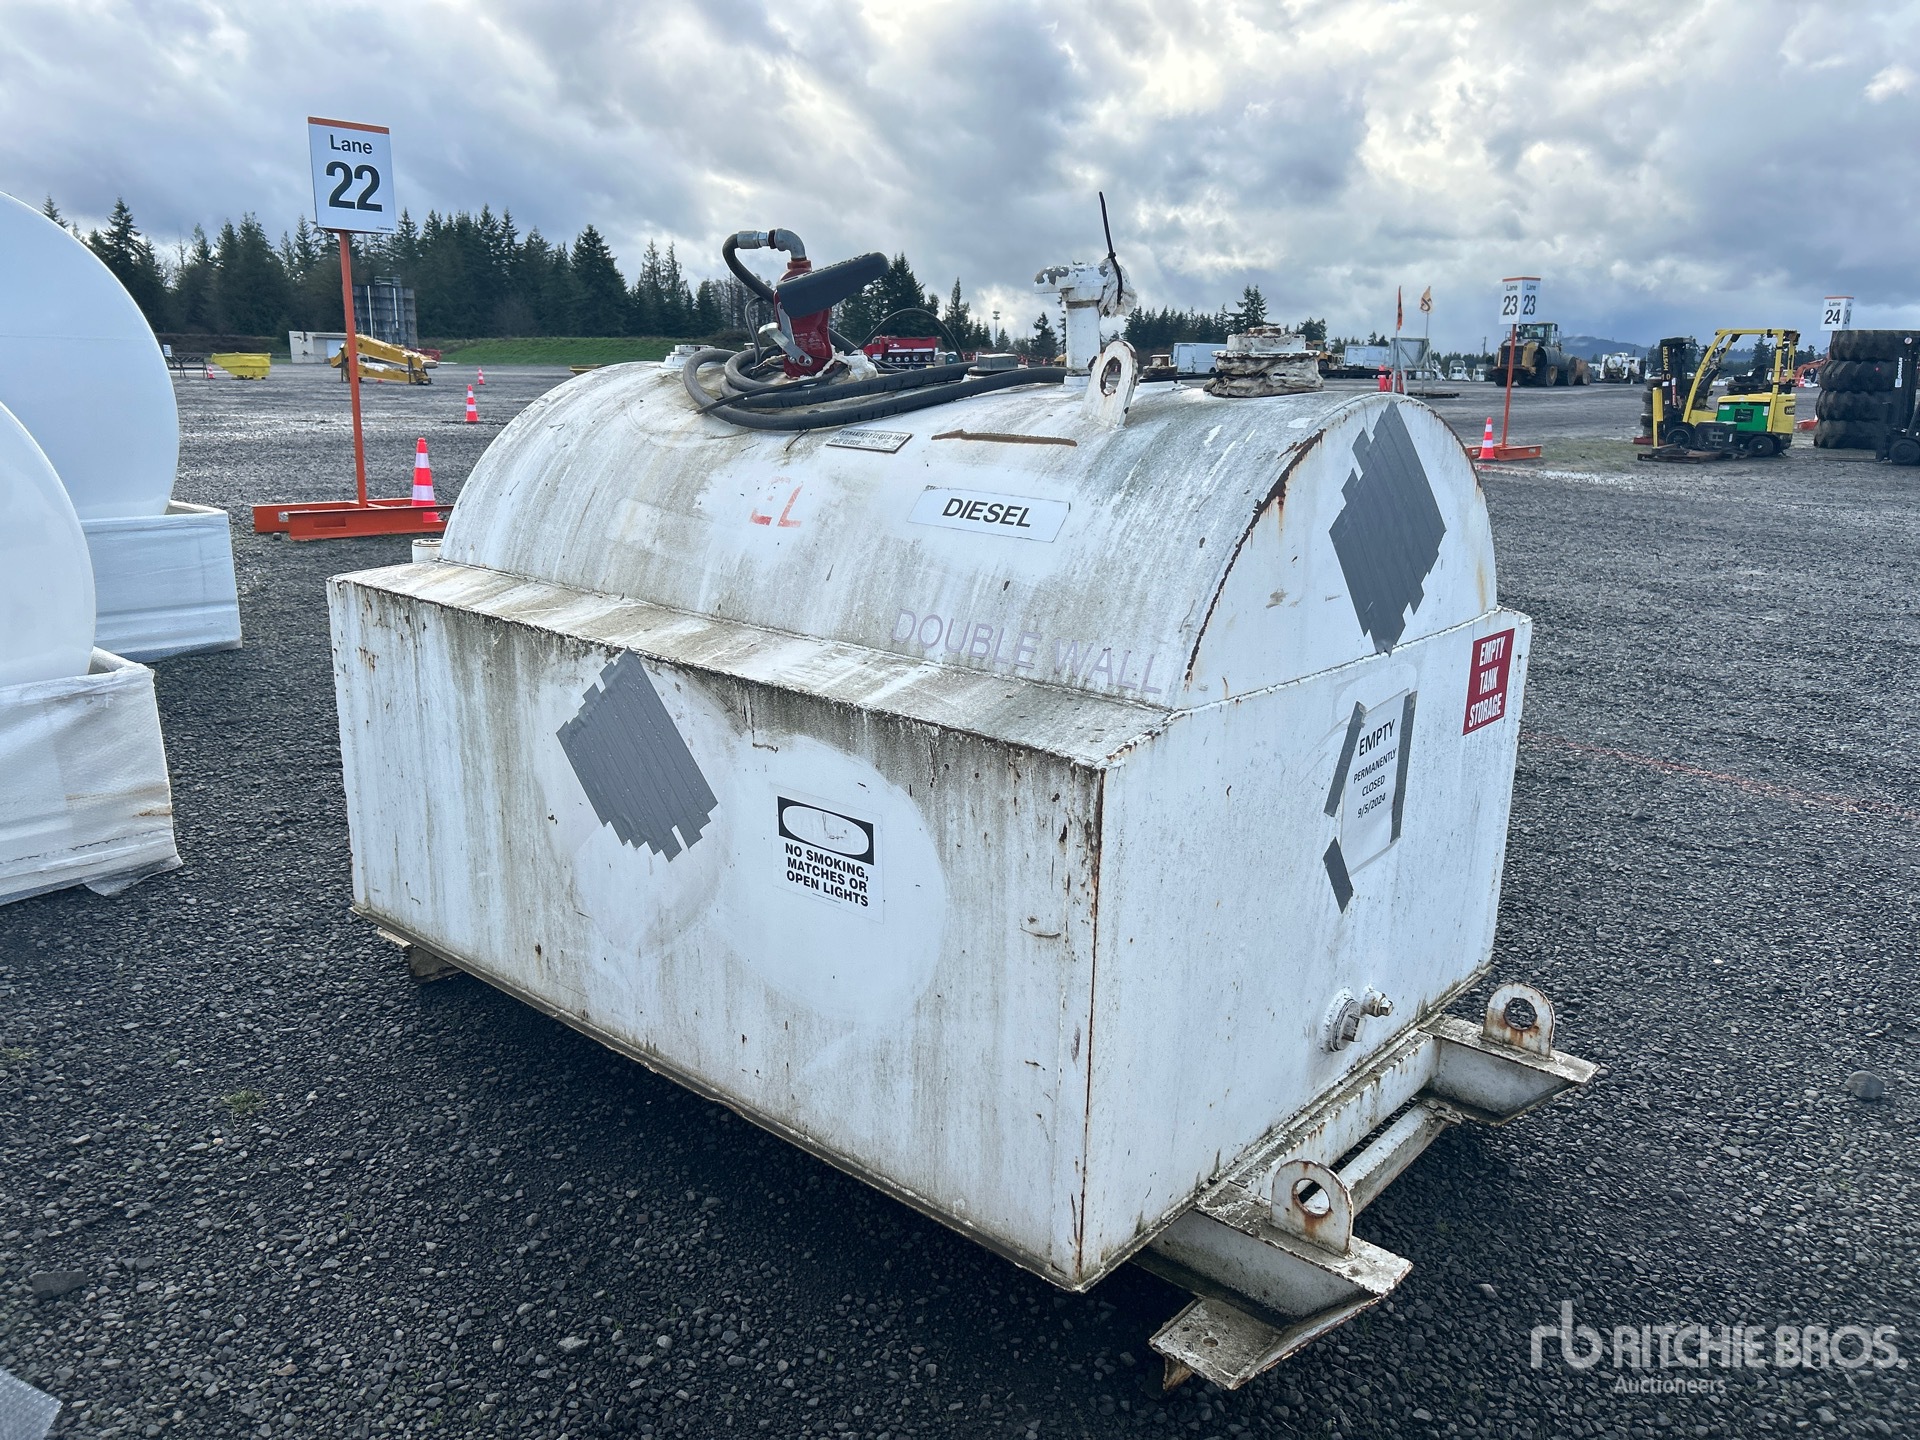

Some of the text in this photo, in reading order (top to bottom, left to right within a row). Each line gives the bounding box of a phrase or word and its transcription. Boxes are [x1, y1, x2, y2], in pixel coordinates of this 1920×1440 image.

[329, 134, 373, 155] Lane
[325, 161, 383, 212] 22
[1502, 294, 1518, 316] 23
[1522, 294, 1536, 316] 23
[1824, 309, 1841, 325] 24
[942, 497, 1032, 528] DIESEL
[891, 609, 1162, 694] DOUBLE WALL
[1479, 636, 1506, 667] EMPTY
[1479, 666, 1499, 695] TANK
[1468, 693, 1503, 728] STORAGE
[1358, 719, 1396, 757] EMPTY
[1353, 748, 1397, 784] PERMANENTLY
[1362, 775, 1386, 797] CLOSED
[1357, 792, 1387, 819] 9/5/2024
[785, 842, 869, 882] NO SMOKING,
[787, 857, 868, 893] MATCHES OR
[786, 870, 819, 891] OPEN
[823, 882, 869, 907] LIGHTS
